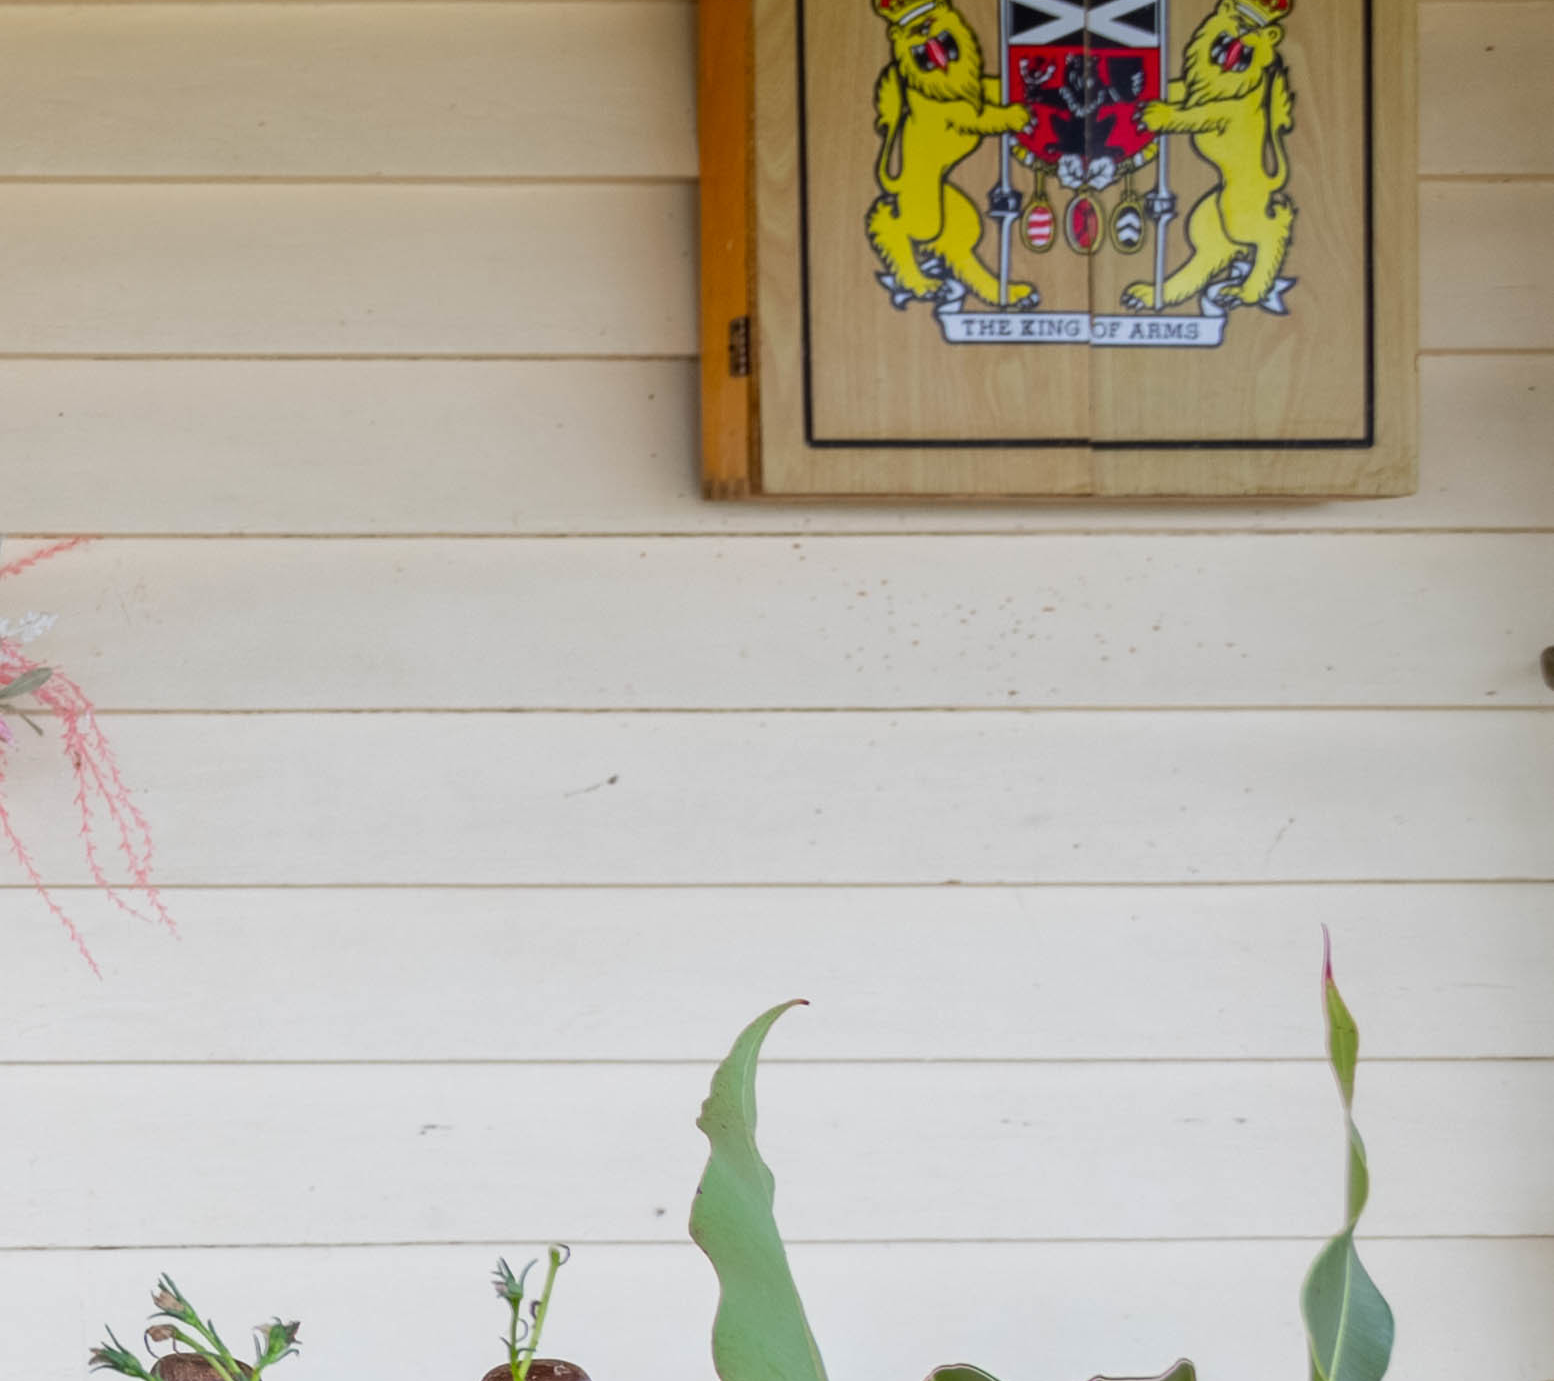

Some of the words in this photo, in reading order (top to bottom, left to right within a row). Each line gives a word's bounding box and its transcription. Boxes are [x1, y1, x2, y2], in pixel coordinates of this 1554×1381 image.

[962, 319, 1013, 337] THE
[1020, 320, 1080, 338] KING
[1090, 321, 1123, 339] OF
[1128, 322, 1200, 340] ARMS
